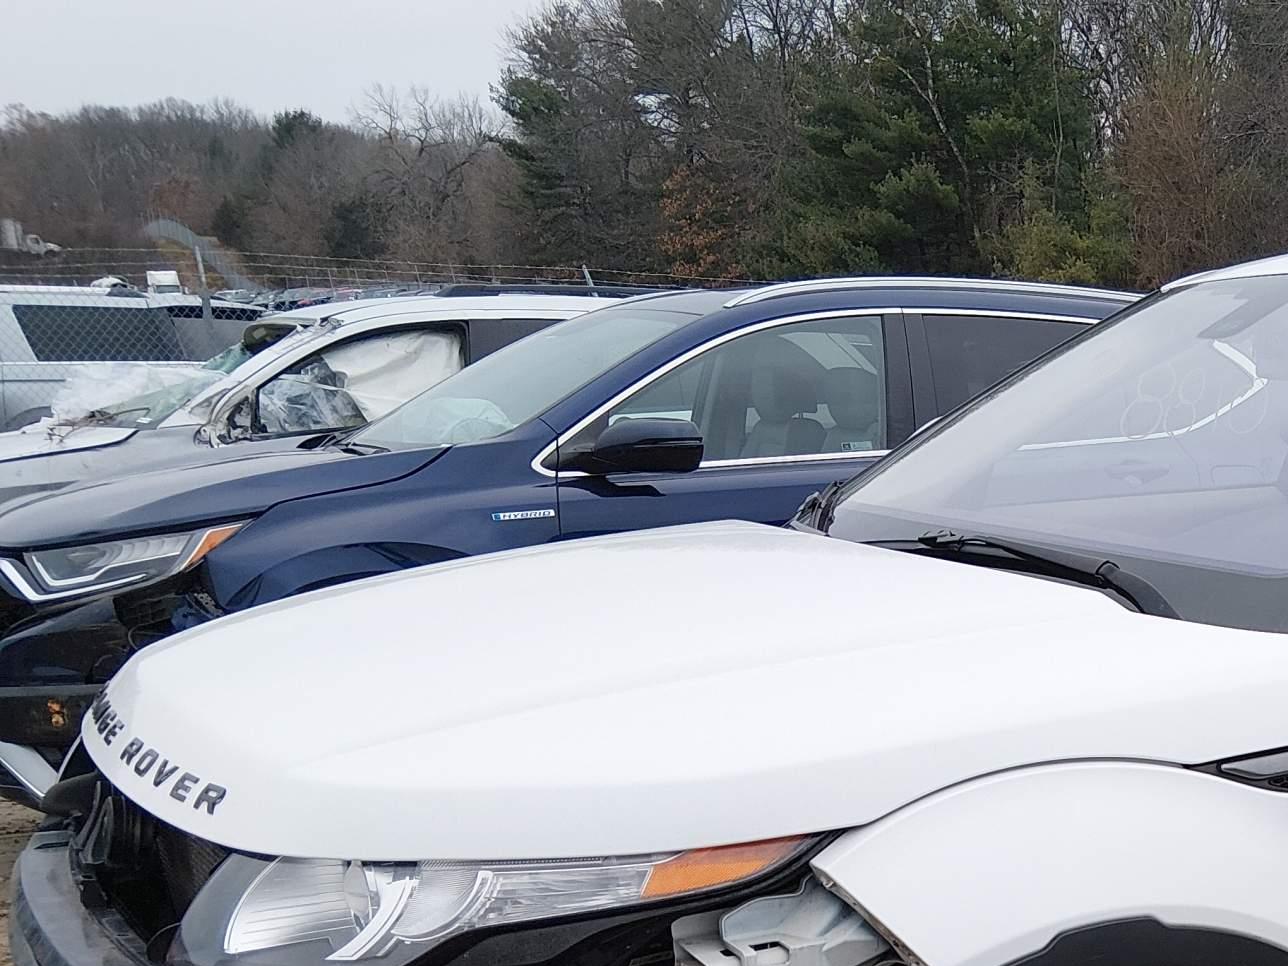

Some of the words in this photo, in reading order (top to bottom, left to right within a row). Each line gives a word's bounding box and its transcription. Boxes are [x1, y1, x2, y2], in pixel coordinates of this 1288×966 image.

[502, 510, 552, 521] HYBRID
[92, 680, 125, 746] NGE
[119, 737, 227, 816] ROVER
